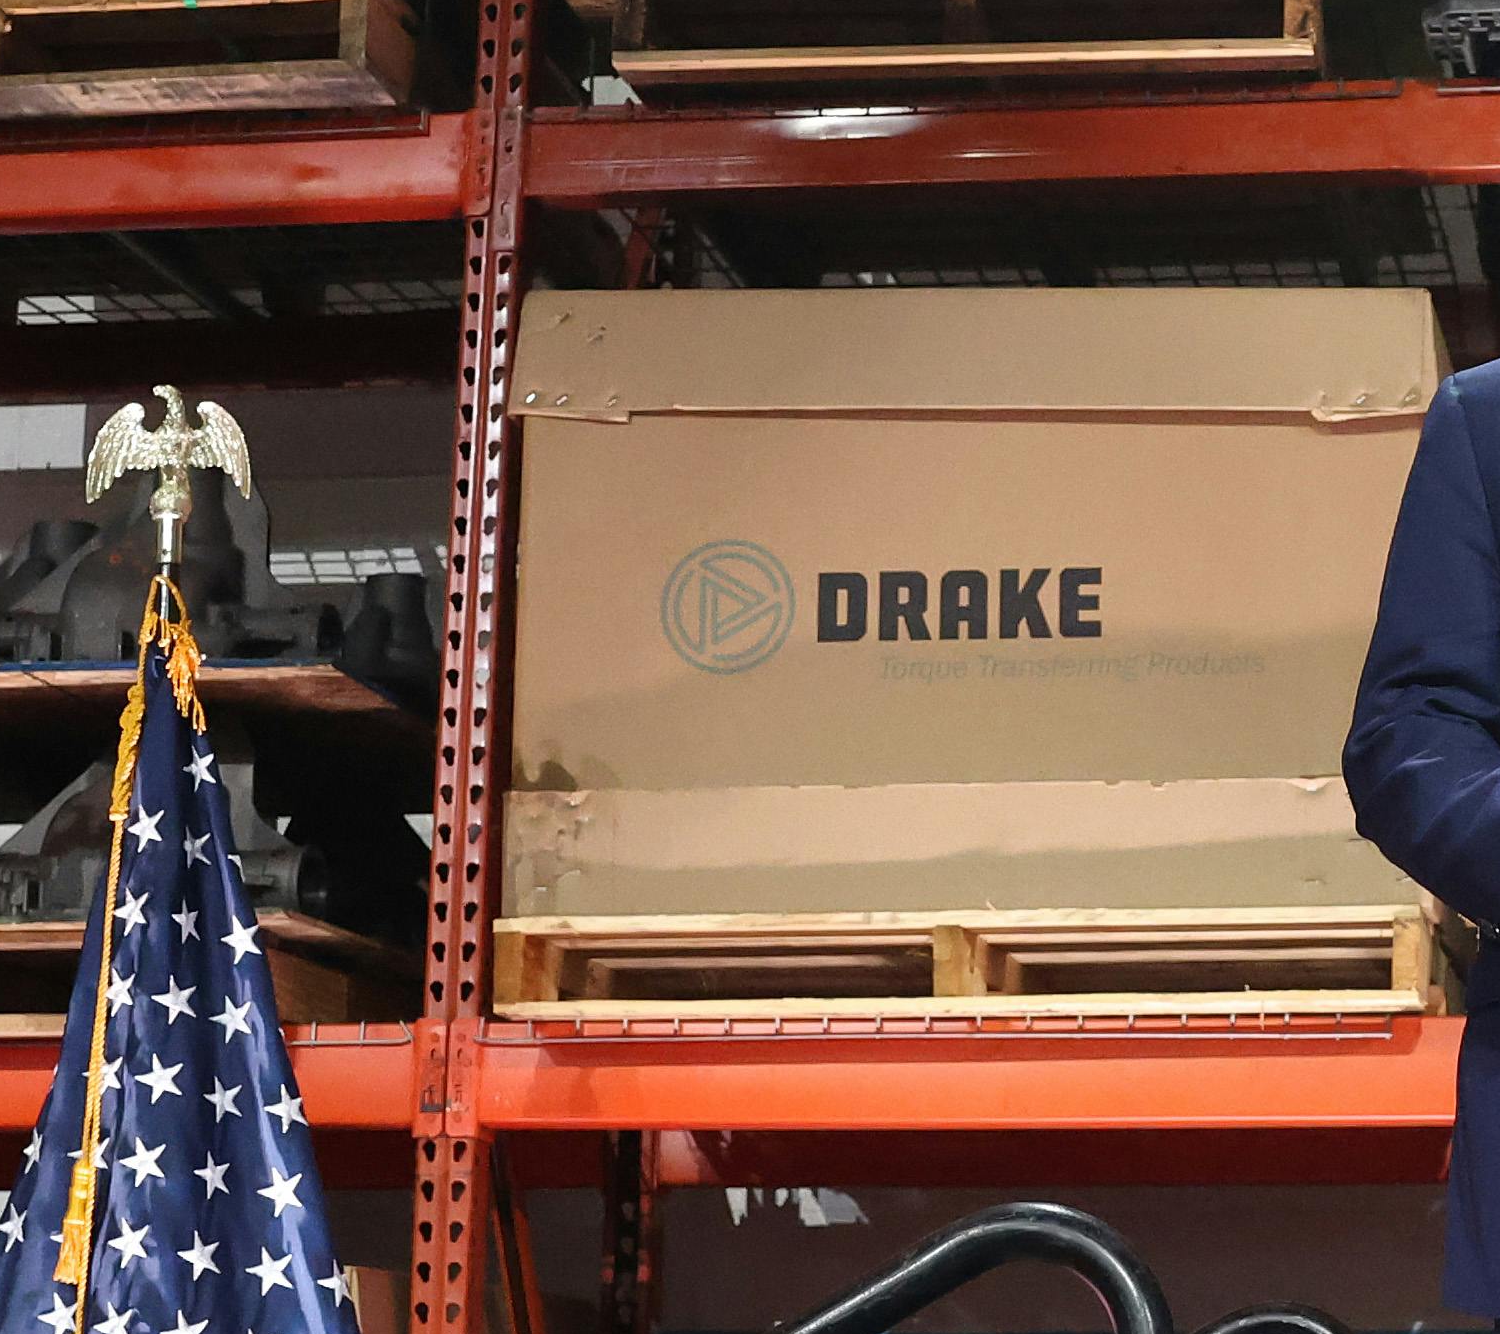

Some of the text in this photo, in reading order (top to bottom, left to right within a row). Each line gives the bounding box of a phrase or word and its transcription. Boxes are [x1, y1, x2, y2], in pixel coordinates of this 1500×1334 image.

[817, 567, 1102, 644] DRAKE
[881, 651, 1267, 684] Torque Transferring Products
